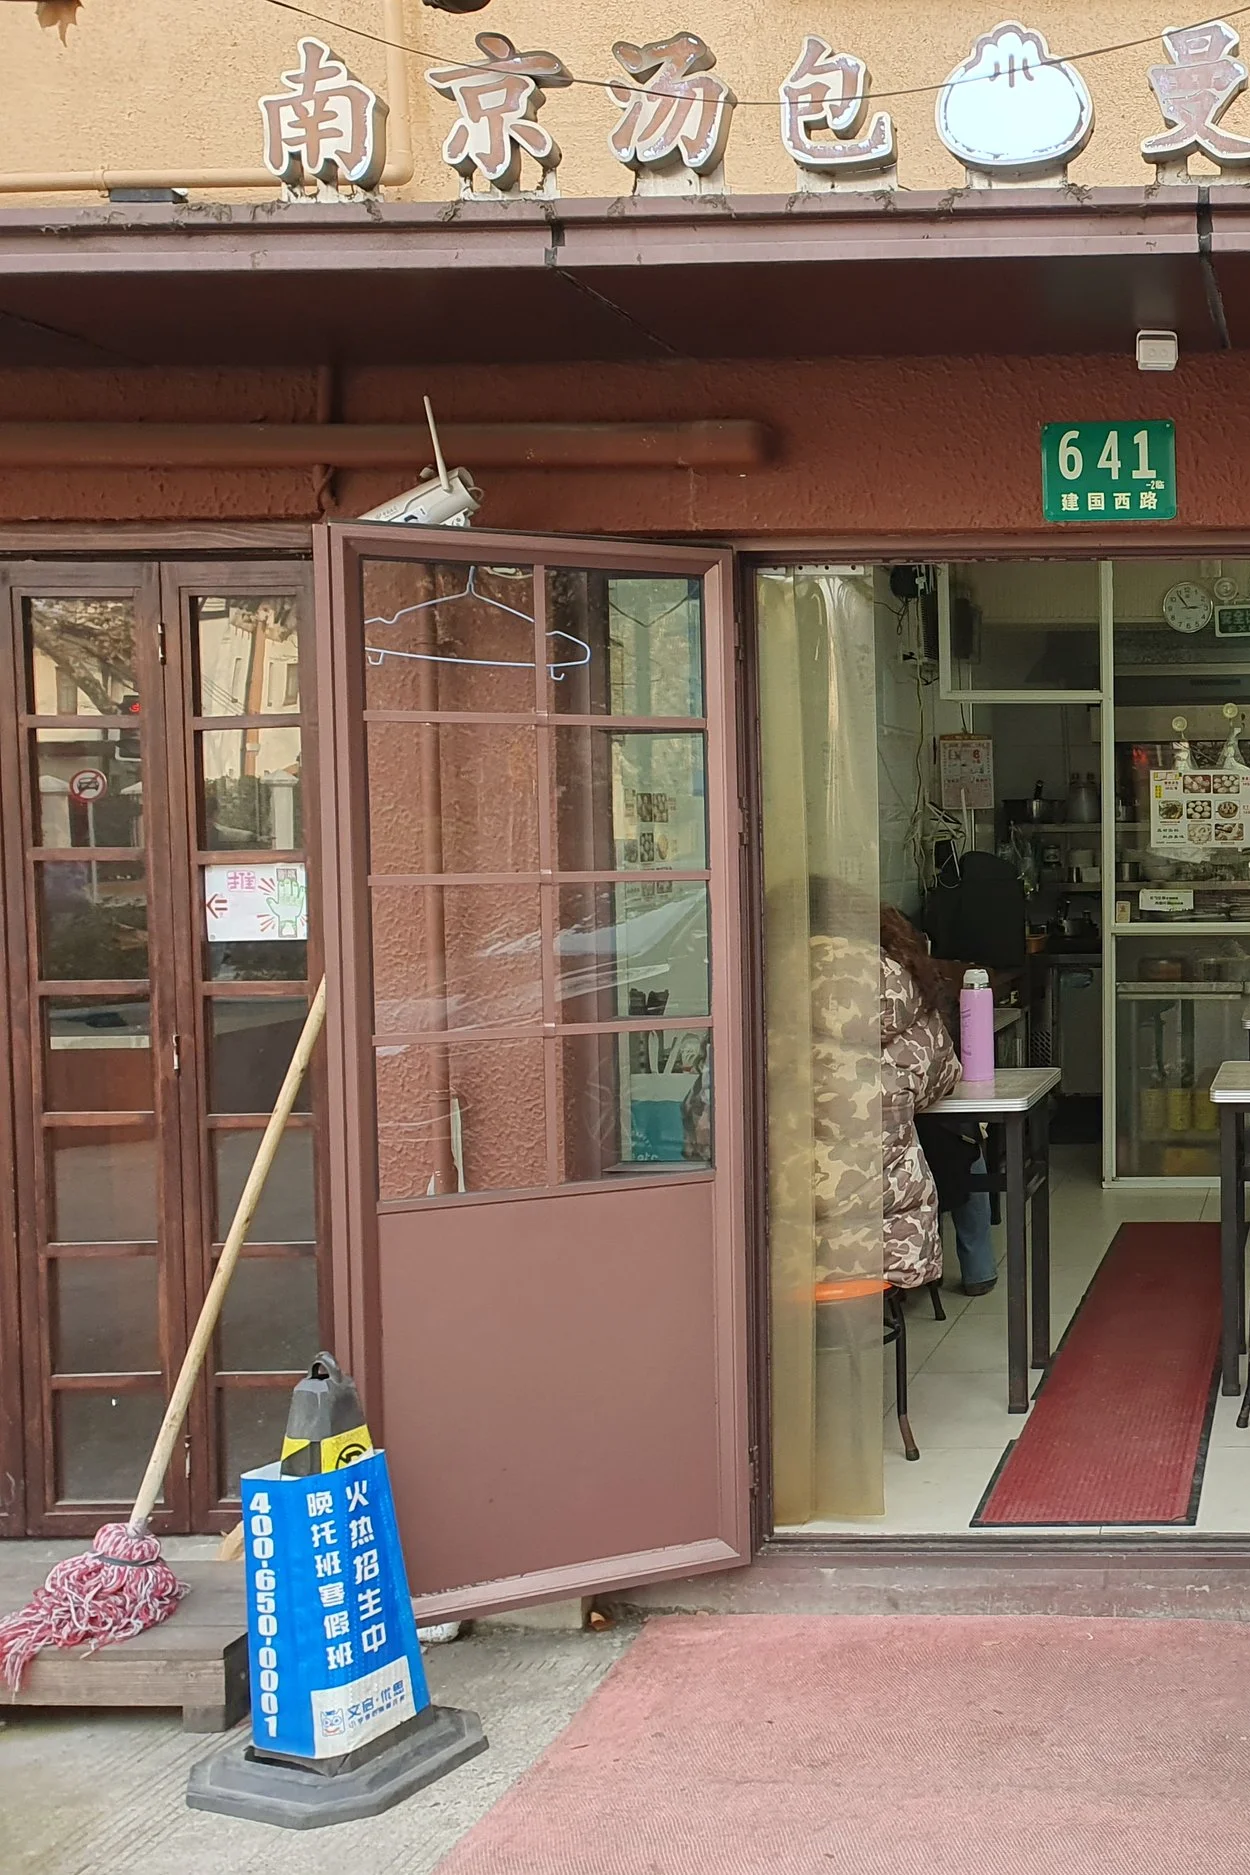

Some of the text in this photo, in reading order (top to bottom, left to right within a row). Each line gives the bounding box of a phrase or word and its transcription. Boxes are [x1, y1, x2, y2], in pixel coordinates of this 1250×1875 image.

[260, 32, 894, 182] 南京汤包
[1058, 430, 1157, 480] 641
[1061, 491, 1158, 511] 建国西路
[228, 871, 256, 890] 推
[306, 1491, 354, 1670] 晚托班寒假班
[345, 1480, 387, 1653] 火热招生中
